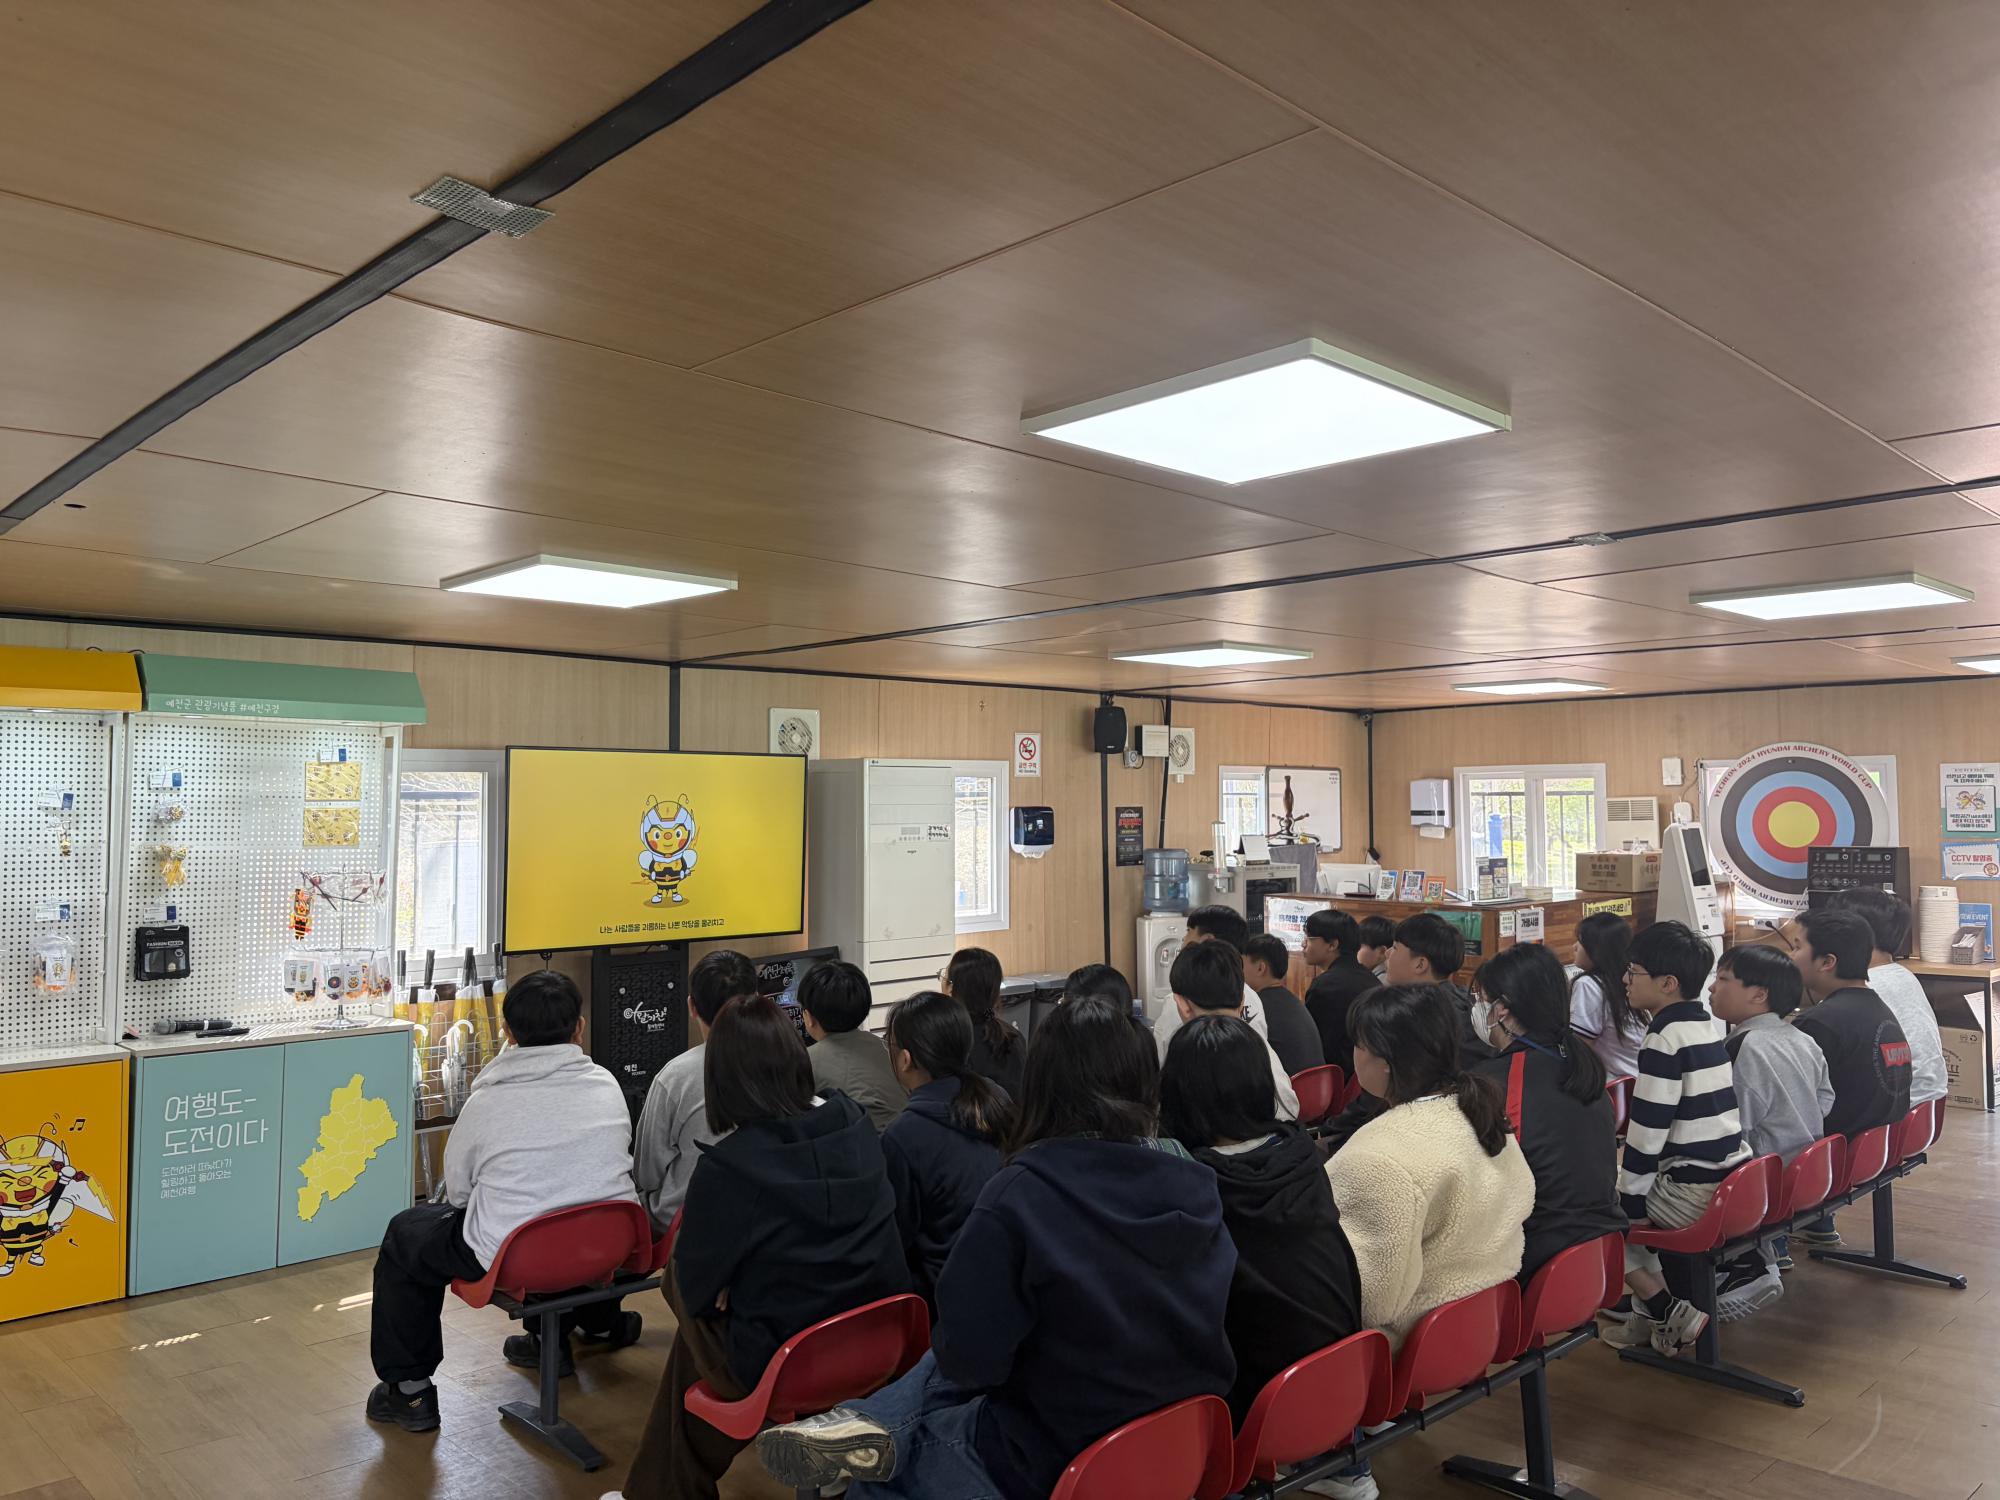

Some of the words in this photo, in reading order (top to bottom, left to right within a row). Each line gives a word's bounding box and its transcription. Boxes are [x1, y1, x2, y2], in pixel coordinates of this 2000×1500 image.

[165, 699, 192, 710] 예천군
[194, 700, 237, 712] 관광기념품
[1737, 755, 1756, 769] 2024
[1757, 745, 1791, 758] HYUNDAI
[1792, 745, 1830, 758] ARCHERY
[1830, 754, 1858, 774] WORLD
[1858, 773, 1873, 790] CUP
[1733, 874, 1758, 895] WORLD
[1758, 891, 1794, 906] ARCHERY
[1972, 912, 1989, 921] EVENT
[614, 924, 640, 933] 사람들을
[642, 922, 667, 931] 괴롭히는
[667, 920, 680, 930] 나쁜
[681, 919, 700, 928] 악당을
[701, 918, 724, 927] 물리치고
[162, 1118, 269, 1157] 도전이다
[162, 1163, 196, 1177] 도전하러
[198, 1158, 232, 1173] 떠났다가
[161, 1174, 197, 1189] 힐링하고
[198, 1170, 232, 1183] 돌아오는
[160, 1186, 197, 1199] 예천여행
